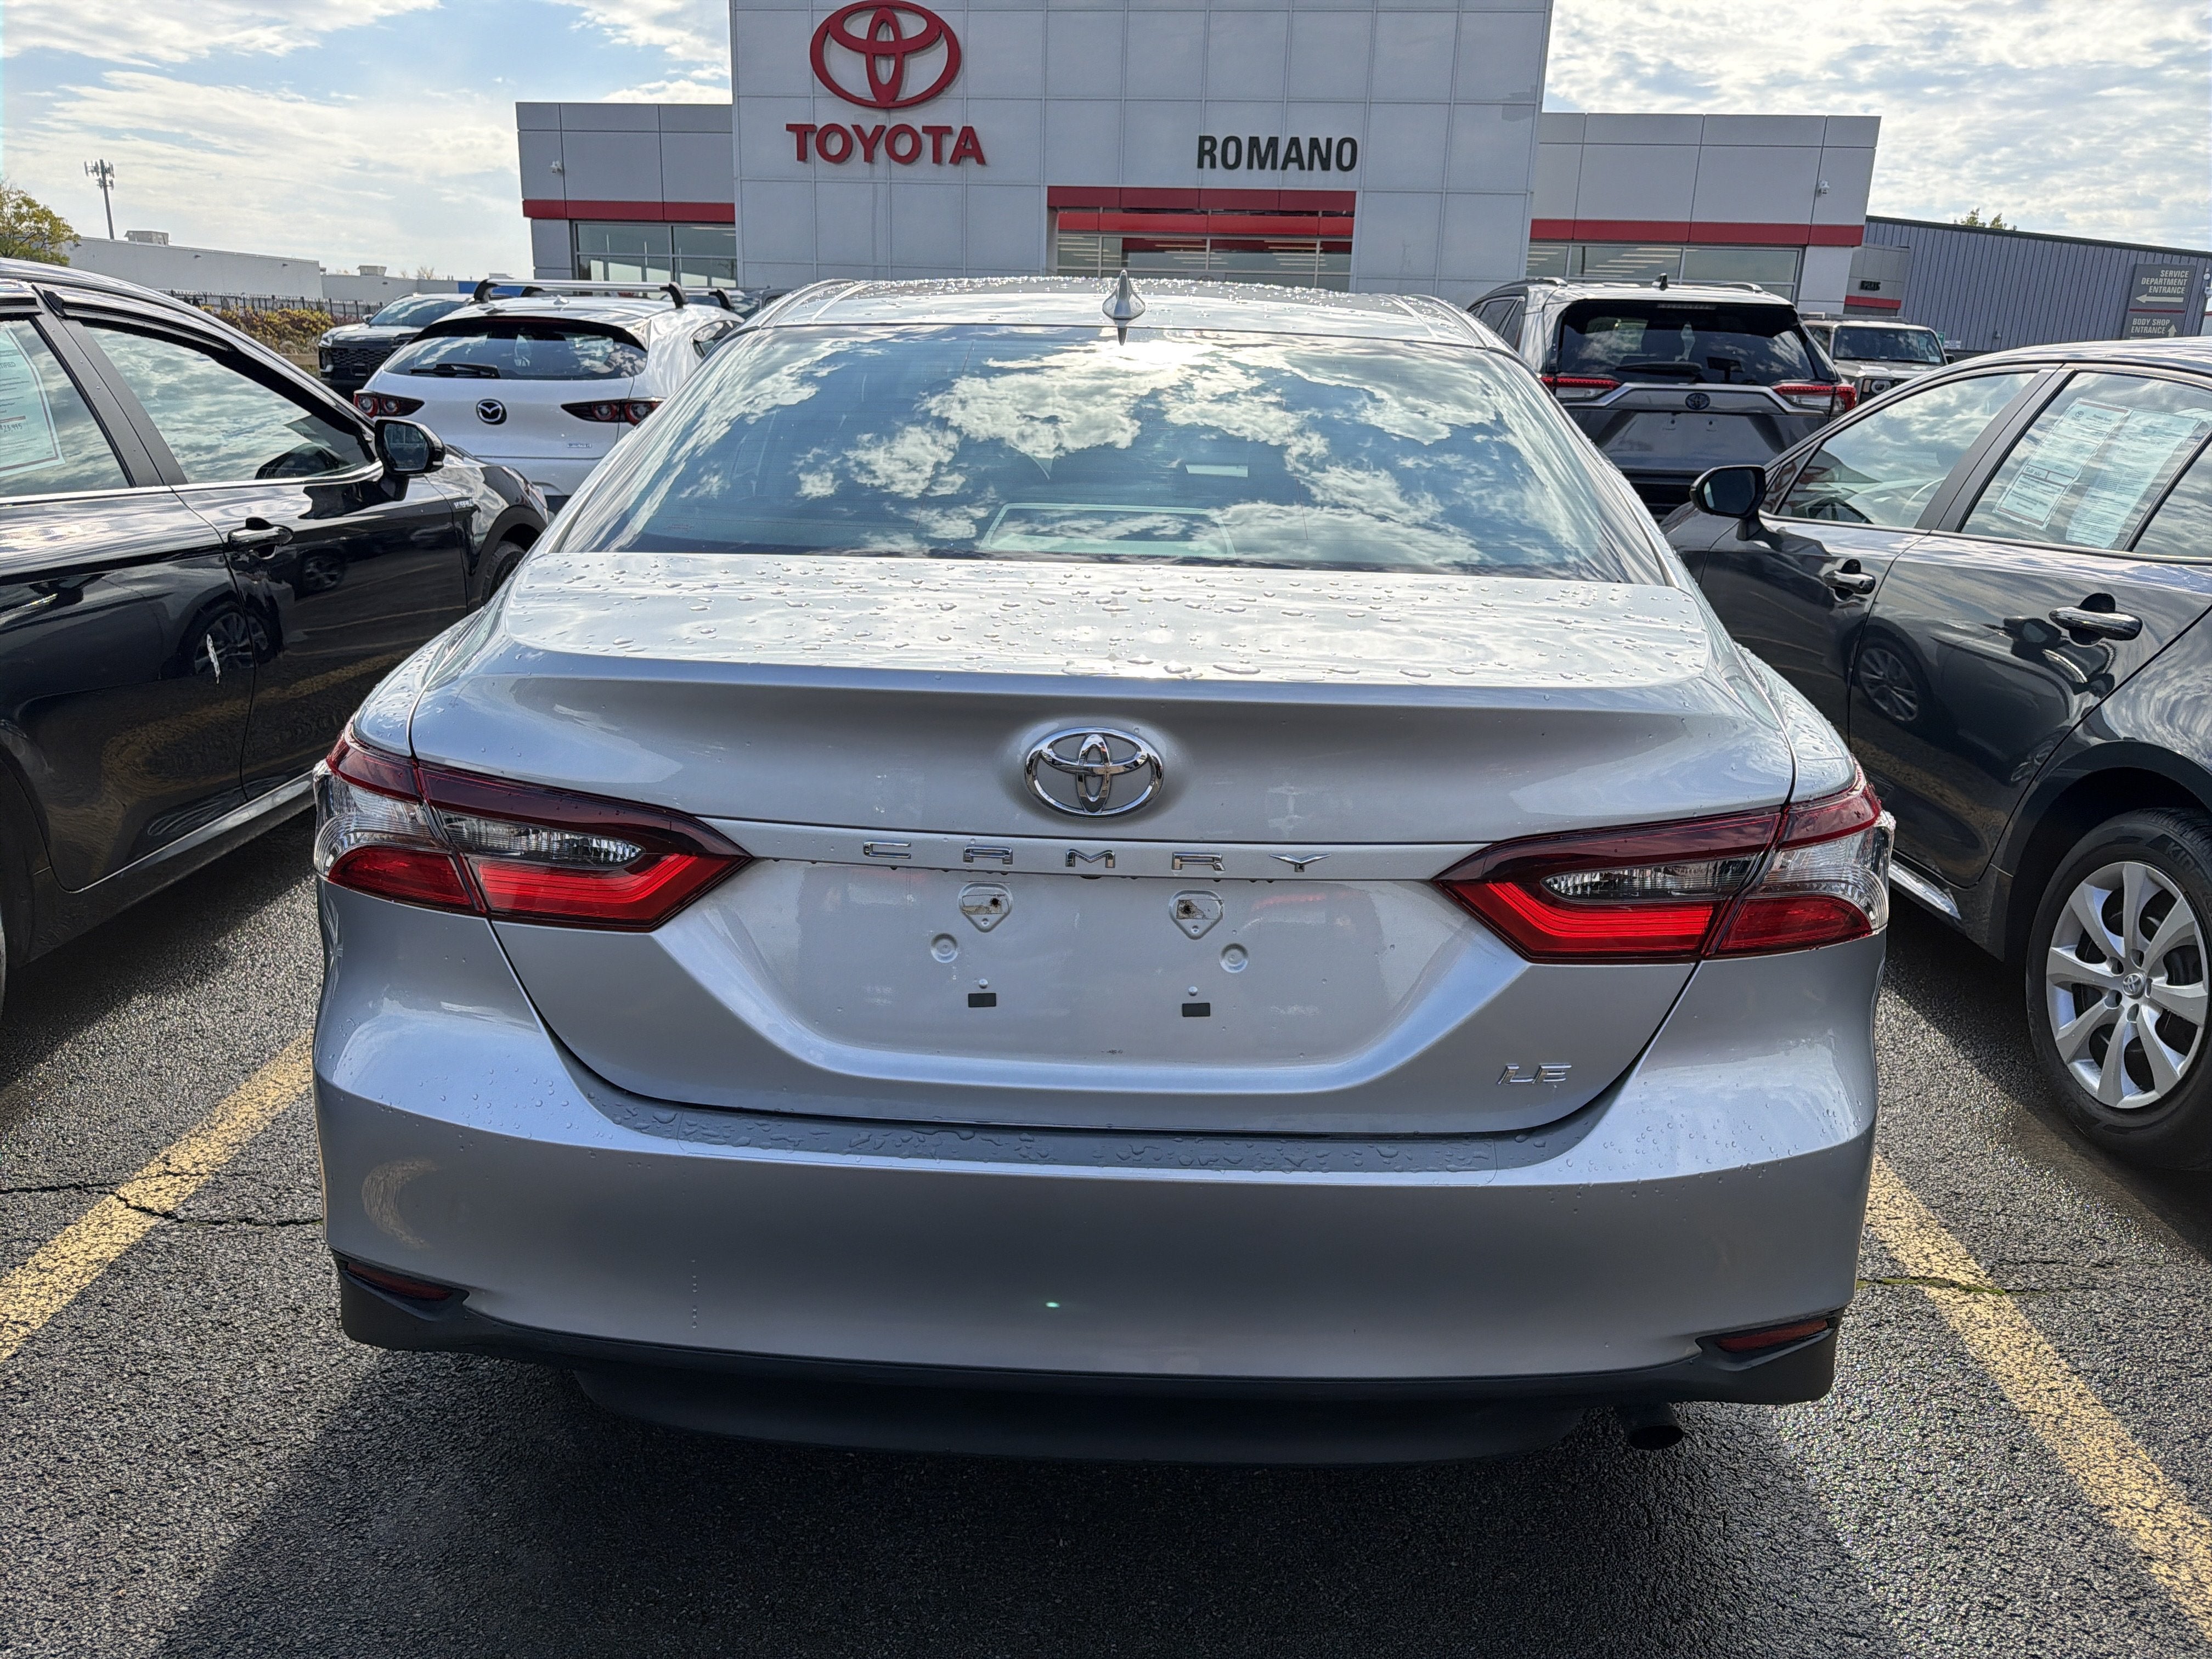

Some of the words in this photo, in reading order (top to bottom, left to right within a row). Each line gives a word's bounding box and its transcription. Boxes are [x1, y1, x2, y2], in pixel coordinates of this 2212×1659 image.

[786, 123, 987, 165] TOYOTA
[1197, 135, 1358, 172] ROMANO
[862, 839, 1332, 873] CAMRY
[1497, 1063, 1572, 1085] LE
